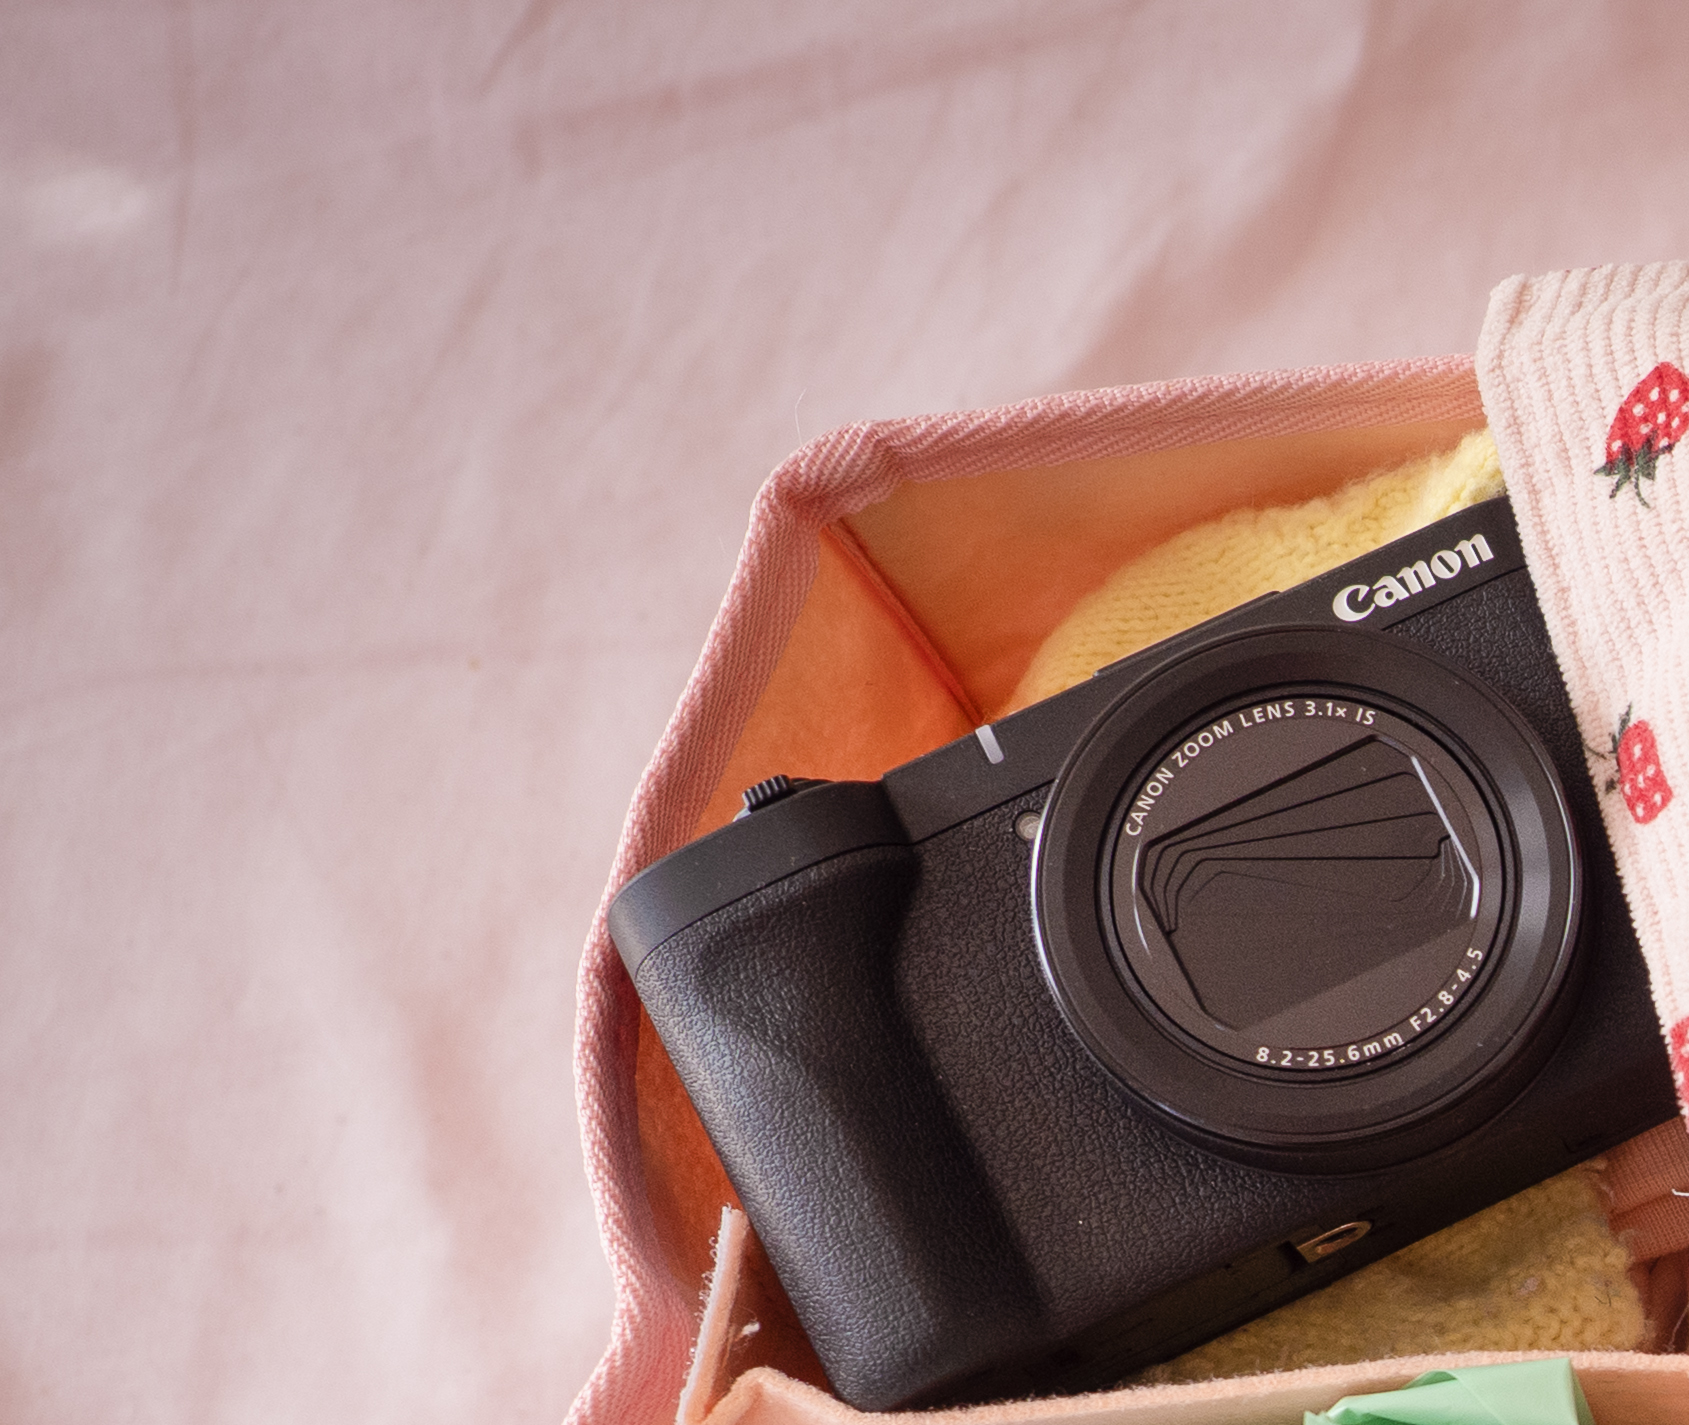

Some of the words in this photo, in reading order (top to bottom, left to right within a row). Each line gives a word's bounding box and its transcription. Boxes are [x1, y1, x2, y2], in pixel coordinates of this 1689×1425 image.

[1331, 531, 1494, 622] Canon
[1125, 766, 1175, 837] CANON
[1171, 719, 1235, 768] ZOOM
[1239, 701, 1296, 729] LENS
[1304, 700, 1348, 719] 3.1x
[1355, 707, 1377, 727] IS
[1255, 1030, 1404, 1068] 8.2-25.6mm
[1409, 946, 1484, 1032] F2.8-4.5
